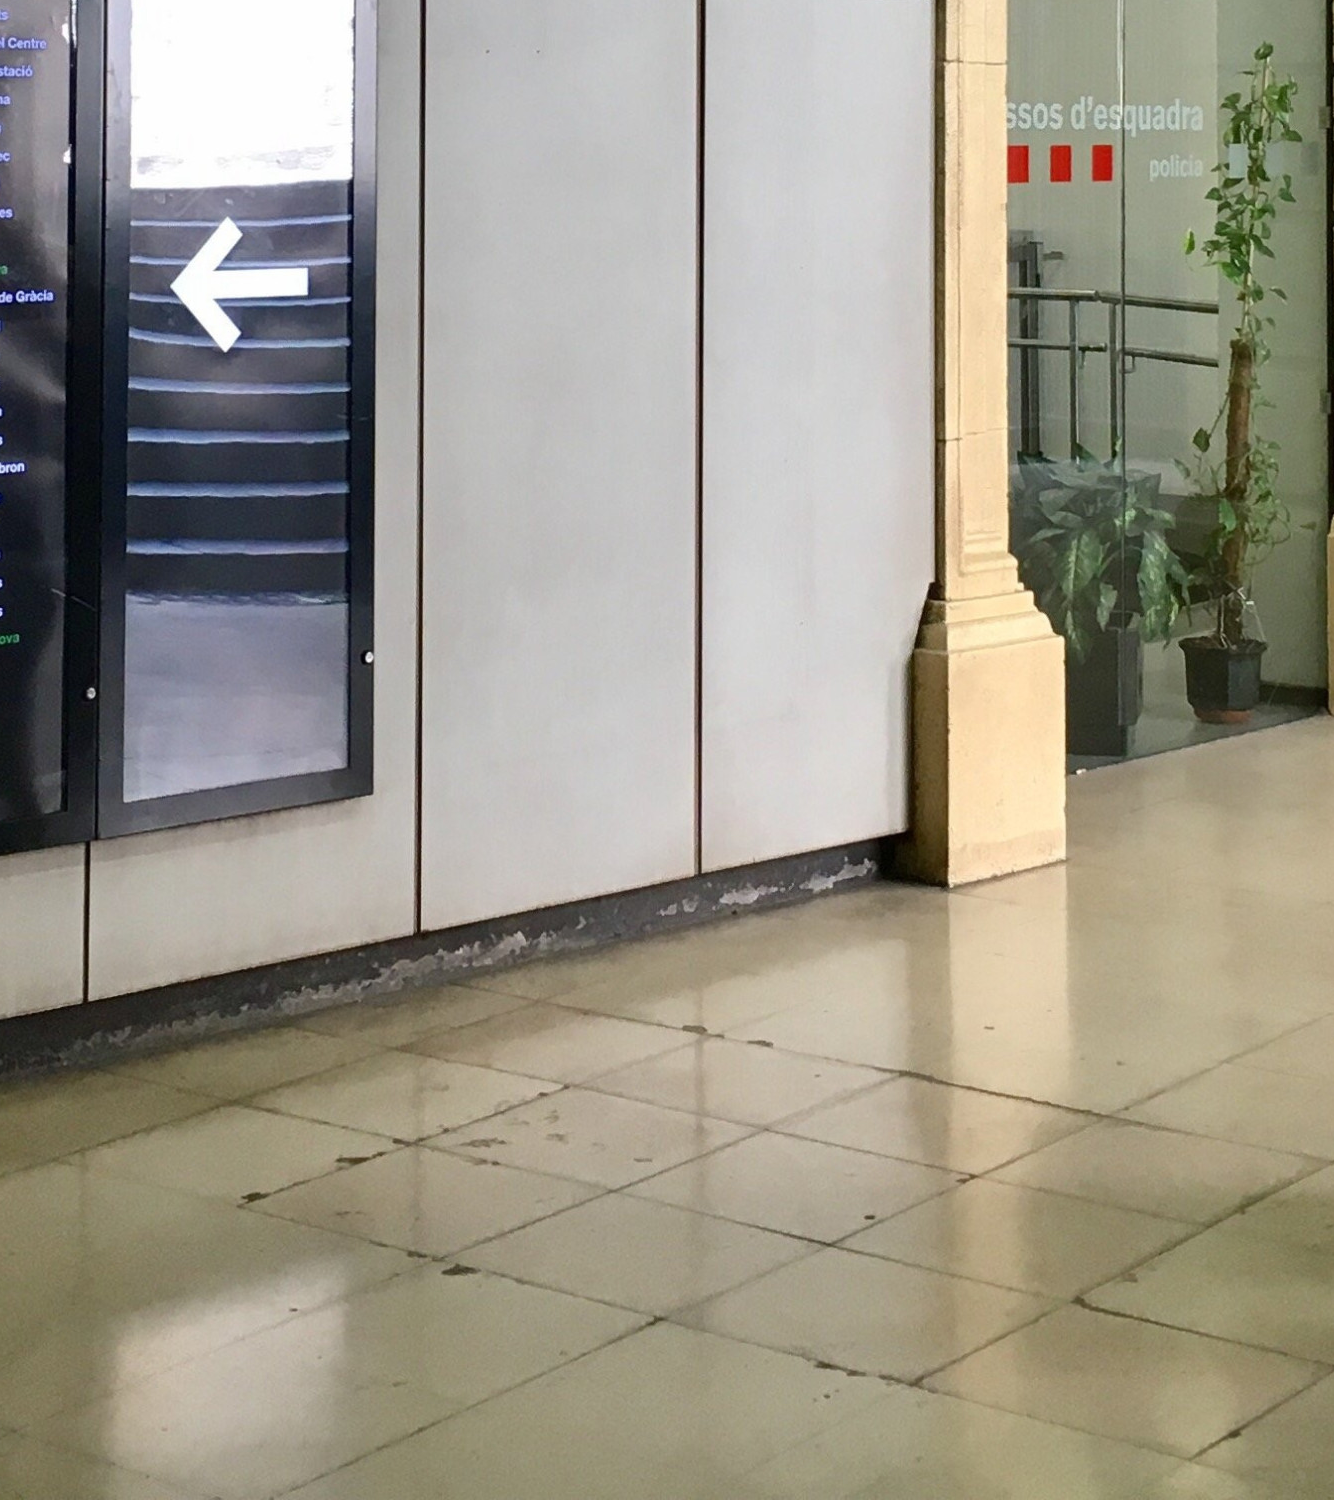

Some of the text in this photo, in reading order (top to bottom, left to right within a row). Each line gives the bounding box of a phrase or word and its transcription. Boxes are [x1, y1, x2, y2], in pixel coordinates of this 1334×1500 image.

[8, 38, 46, 49] Centre
[1007, 96, 1204, 138] ssos d'esquadra
[1149, 155, 1203, 182] policia
[16, 290, 53, 302] Gràcia
